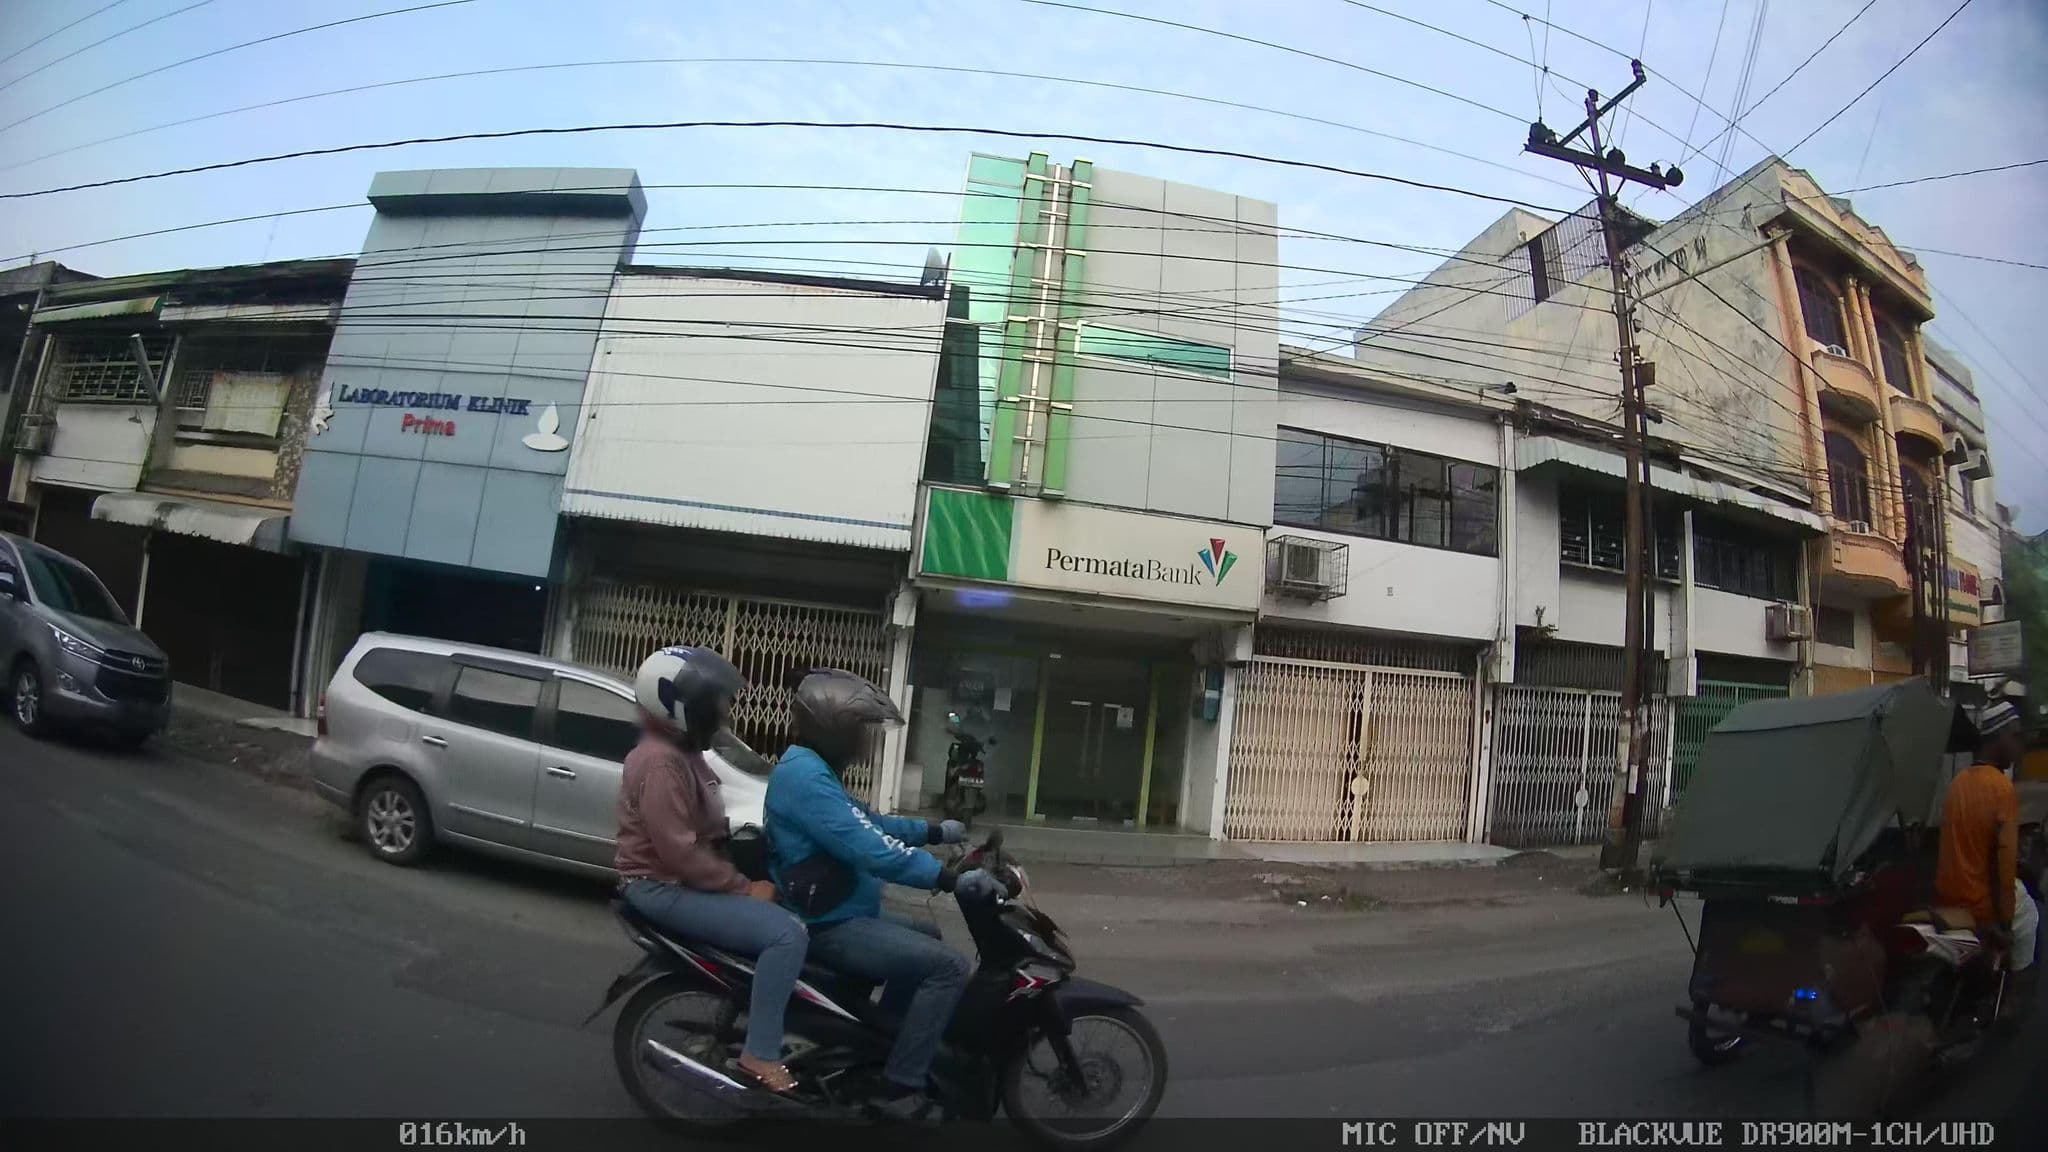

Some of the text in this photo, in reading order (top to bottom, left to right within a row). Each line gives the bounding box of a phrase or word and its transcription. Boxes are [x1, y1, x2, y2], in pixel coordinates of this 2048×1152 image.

[339, 384, 532, 415] LABORATORIUM KLINIK
[401, 413, 455, 436] Prima
[1045, 548, 1202, 585] PermataBank
